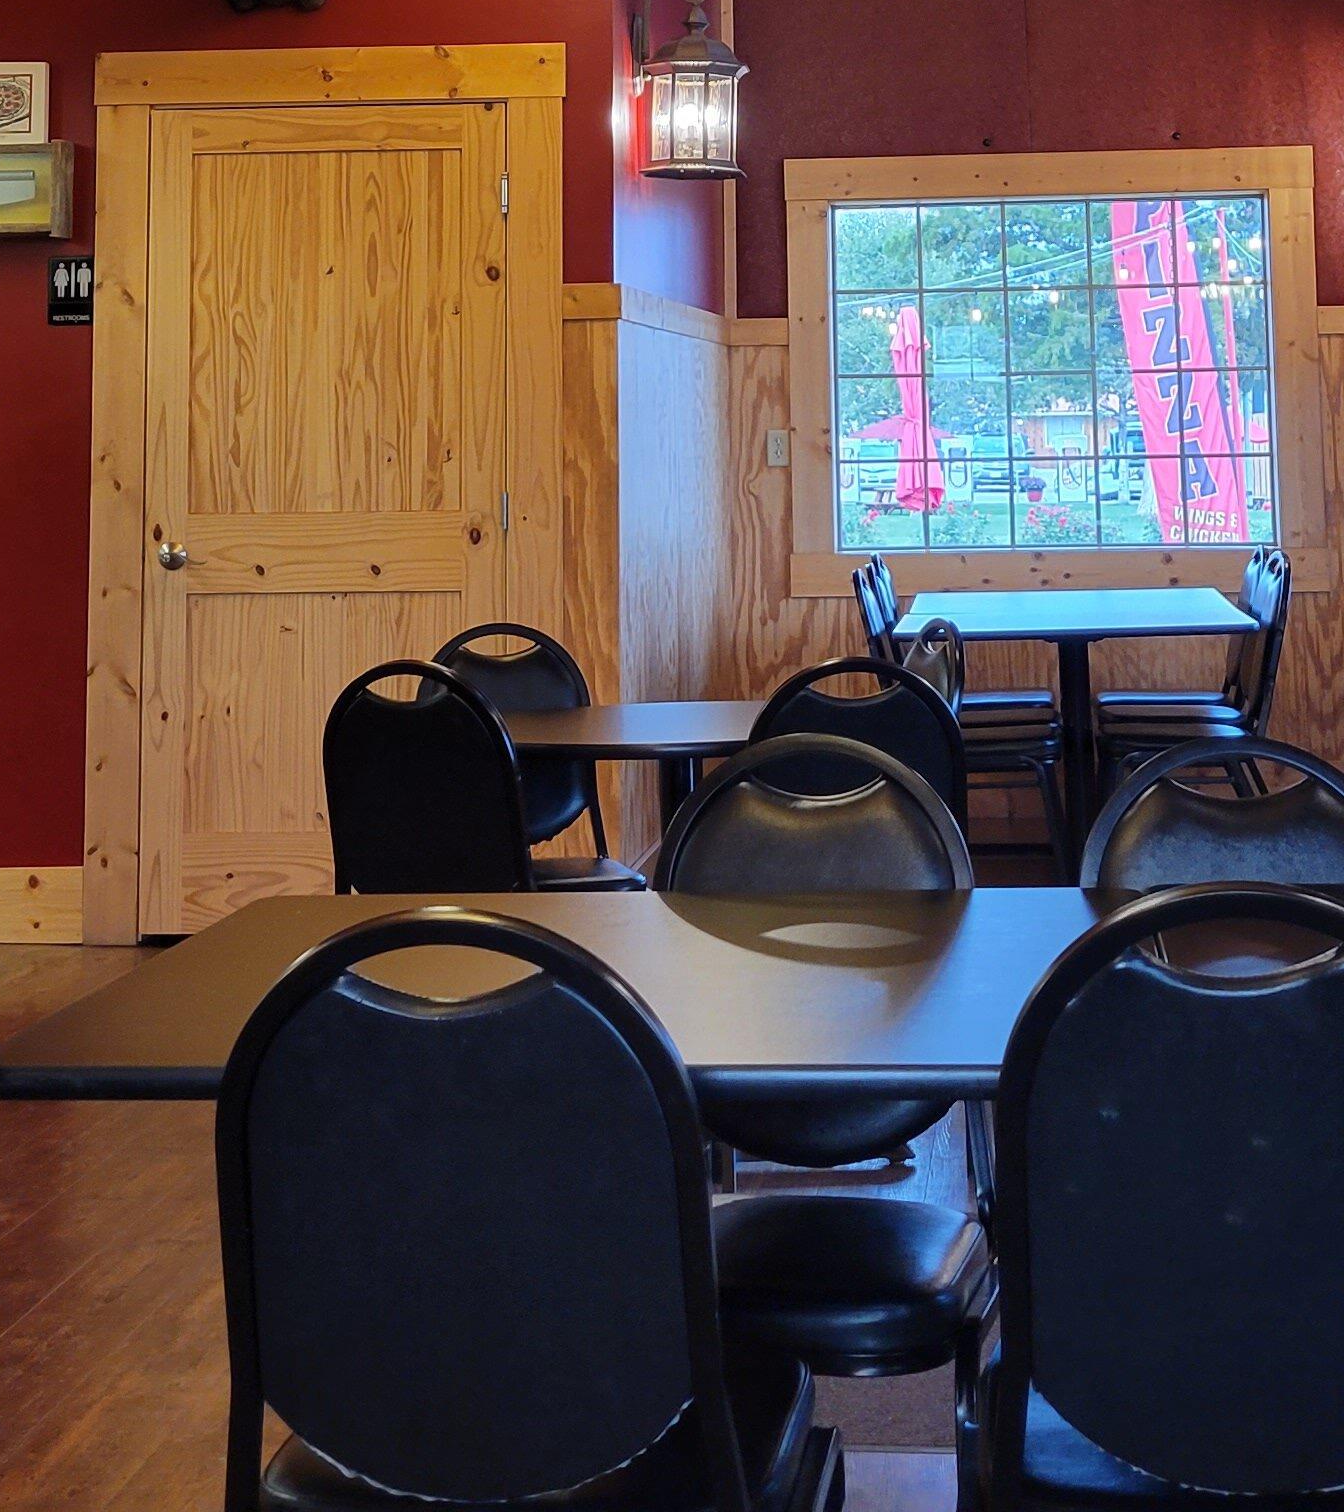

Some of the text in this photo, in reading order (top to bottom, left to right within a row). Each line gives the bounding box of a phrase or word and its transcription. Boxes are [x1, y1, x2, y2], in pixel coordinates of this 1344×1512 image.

[52, 314, 91, 322] RESTROOMS
[1133, 200, 1220, 503] PIZZA
[1174, 505, 1238, 528] WINGS &
